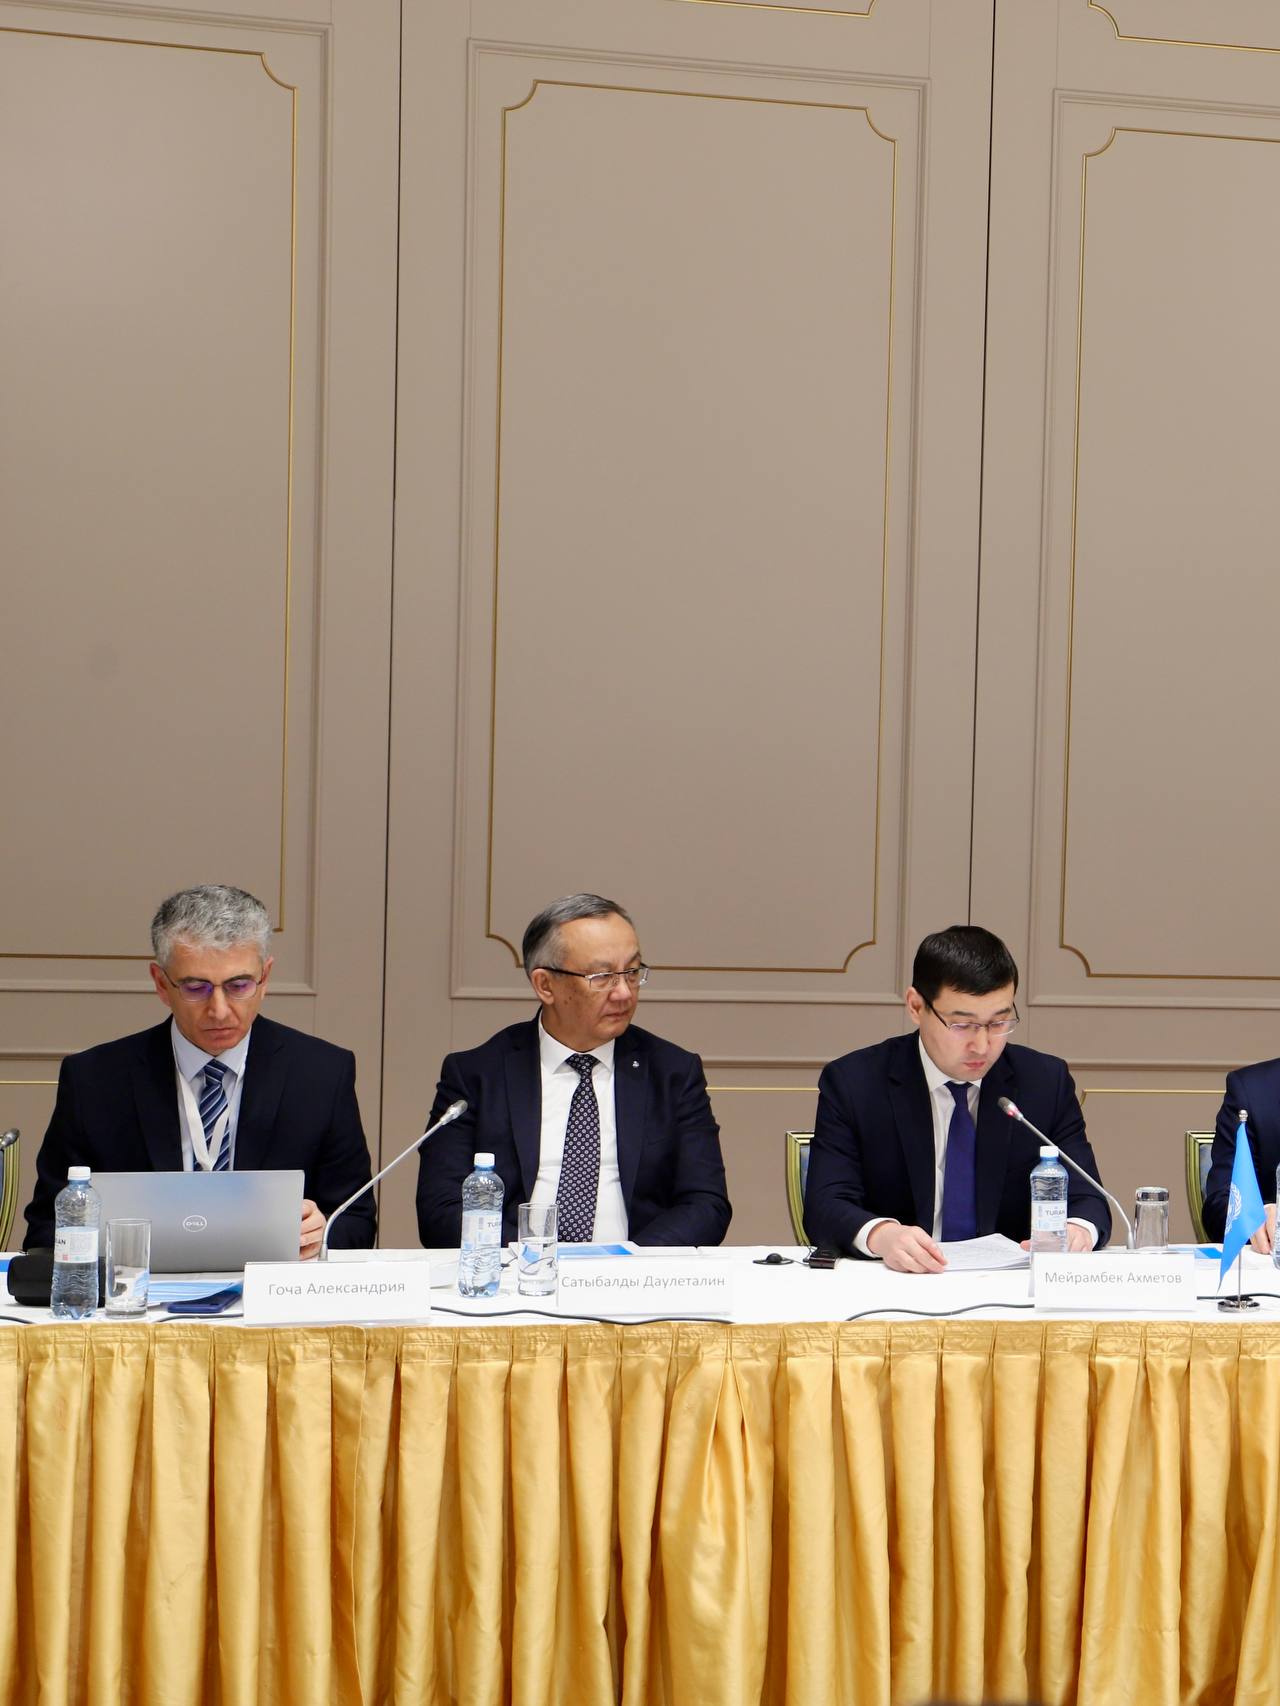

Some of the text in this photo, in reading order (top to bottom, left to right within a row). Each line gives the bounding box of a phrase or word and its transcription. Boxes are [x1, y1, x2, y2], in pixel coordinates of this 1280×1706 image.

[561, 1275, 725, 1289] Сатыбалды Даулеталин
[1045, 1272, 1182, 1285] Мейрамбек Ахметов
[268, 1282, 405, 1296] Гоча Александрия
